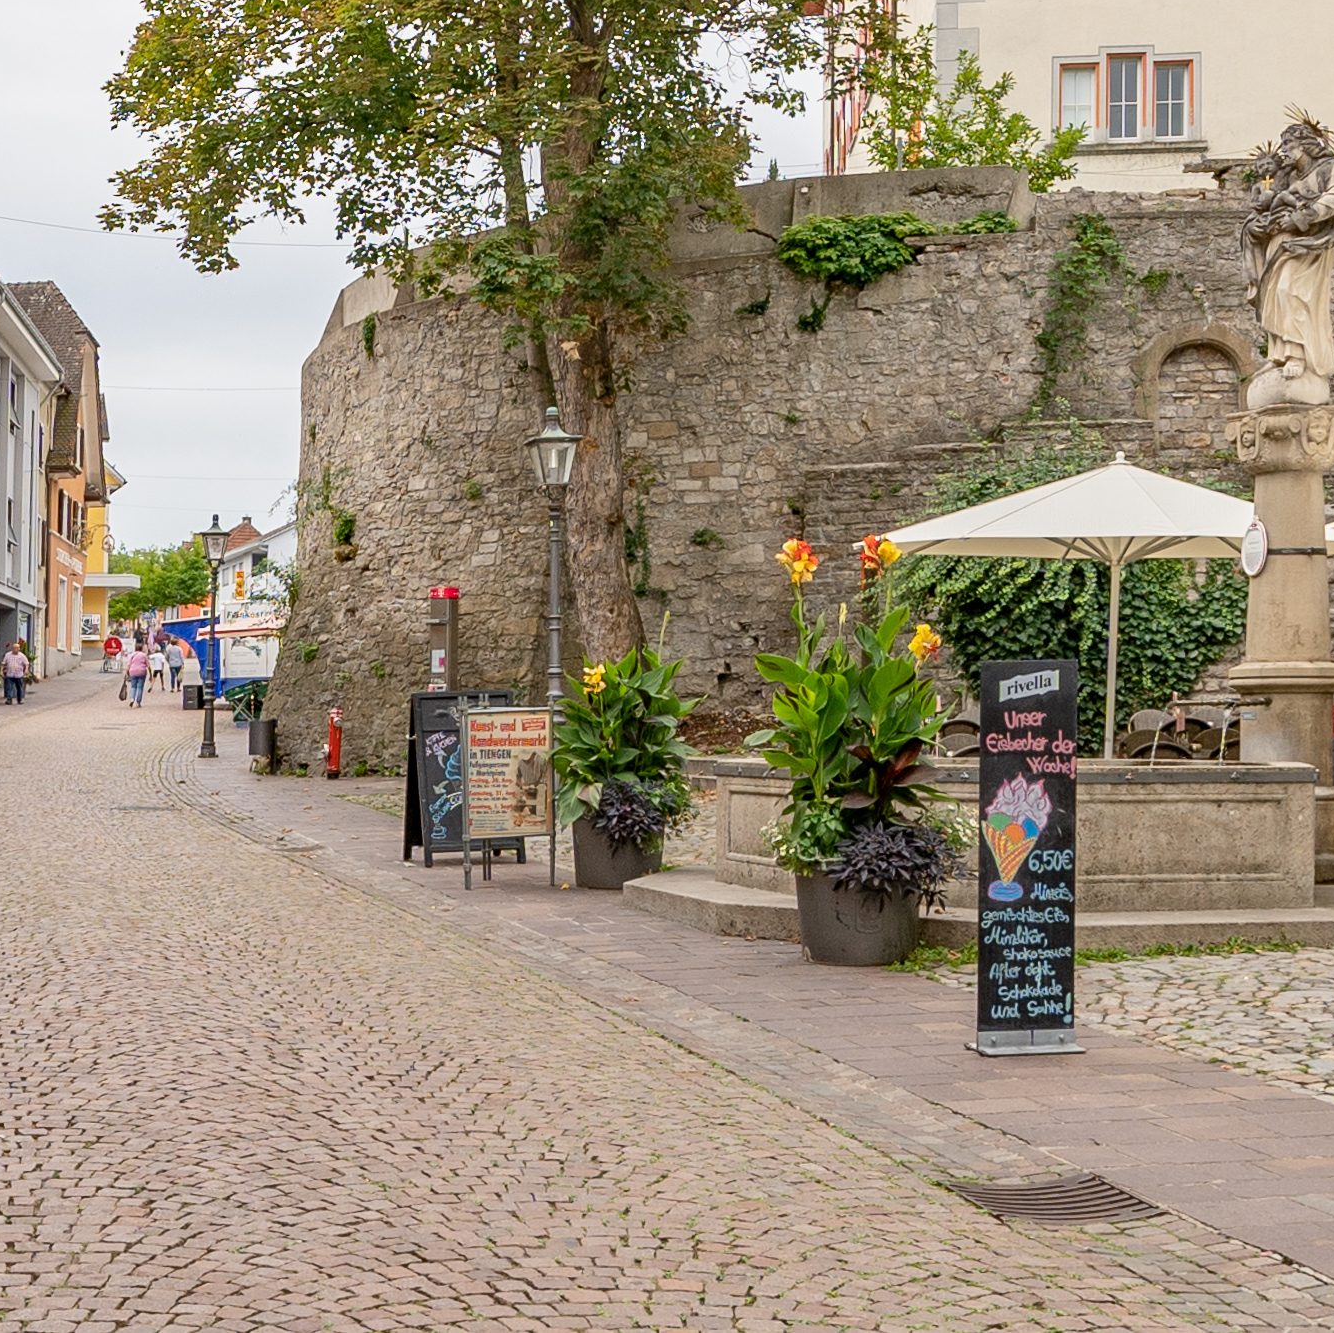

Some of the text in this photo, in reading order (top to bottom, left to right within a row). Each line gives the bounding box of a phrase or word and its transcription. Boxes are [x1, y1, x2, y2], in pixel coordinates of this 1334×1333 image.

[1007, 674, 1052, 696] rivella
[1004, 710, 1047, 729] Unser
[470, 733, 547, 748] Handwerkermarkt
[985, 729, 1077, 754] Eisbecher der
[470, 749, 512, 760] in TIENGEN
[1026, 755, 1077, 780] Woche!
[1028, 849, 1074, 874] 6,50€
